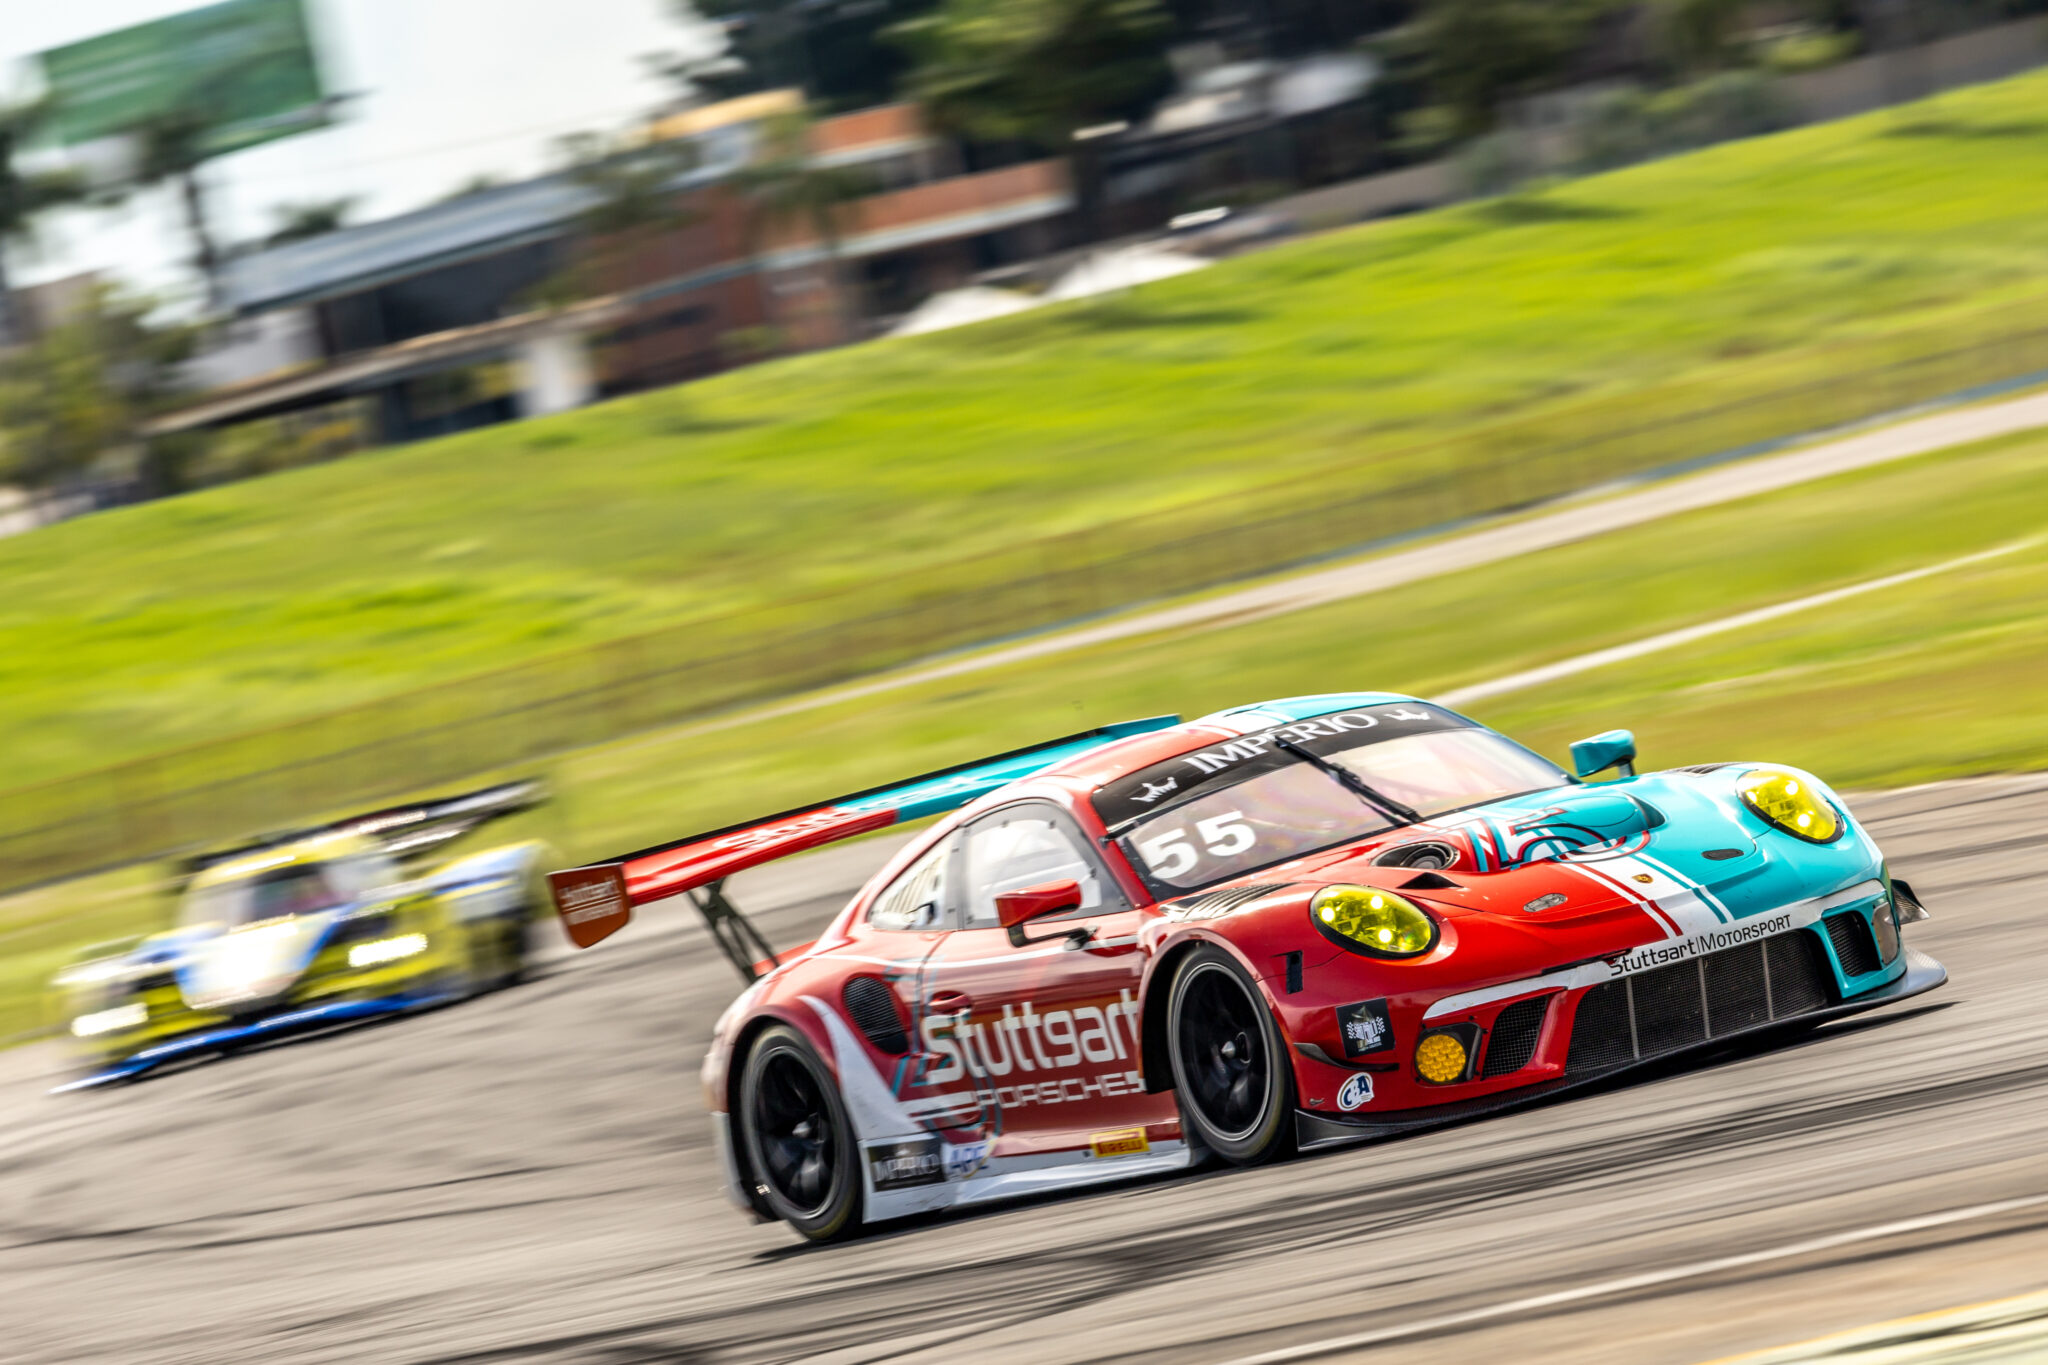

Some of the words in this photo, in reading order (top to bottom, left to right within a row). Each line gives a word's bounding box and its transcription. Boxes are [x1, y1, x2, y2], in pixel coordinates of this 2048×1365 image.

[1140, 810, 1257, 879] 55
[922, 988, 1139, 1085] Stuttgart
[972, 1072, 1129, 1109] PORSCHE
